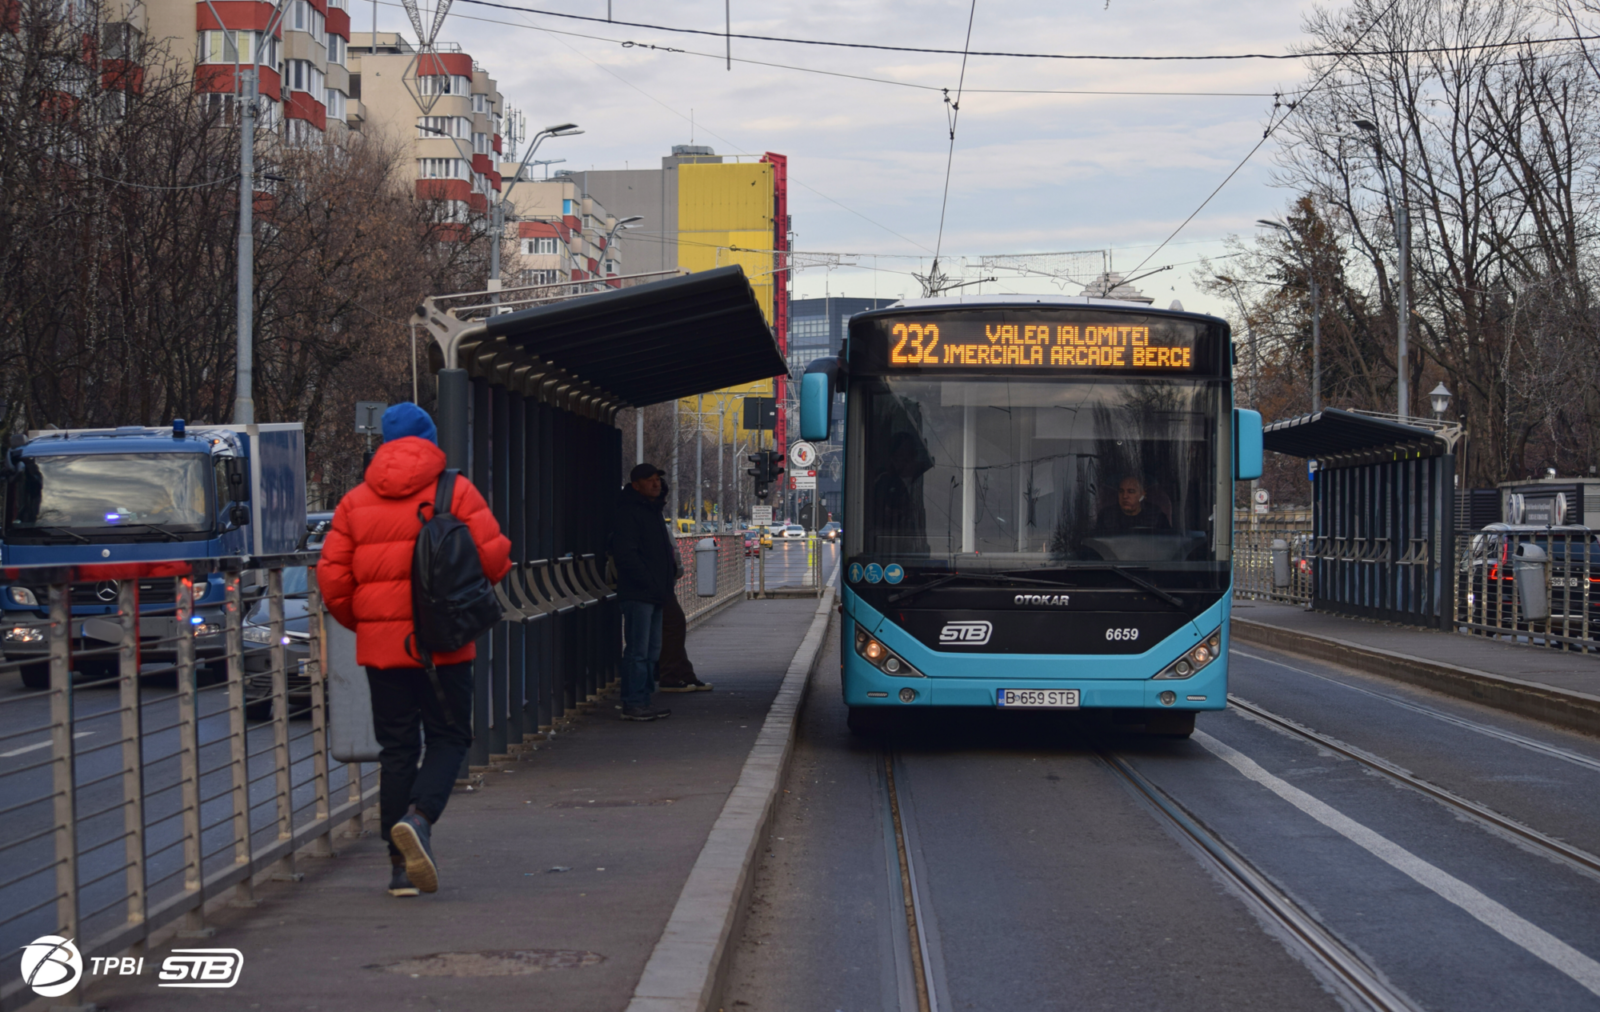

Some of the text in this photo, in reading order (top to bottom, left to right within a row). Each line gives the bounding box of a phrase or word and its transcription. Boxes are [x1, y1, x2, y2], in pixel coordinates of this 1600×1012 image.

[892, 323, 939, 363] 232
[986, 325, 1149, 346] VALEA IALOMITEI
[1051, 346, 1125, 366] ARCADE
[1014, 595, 1069, 605] OTOKAR
[939, 624, 989, 642] STB
[1105, 628, 1139, 641] 6659
[1048, 691, 1076, 705] STB
